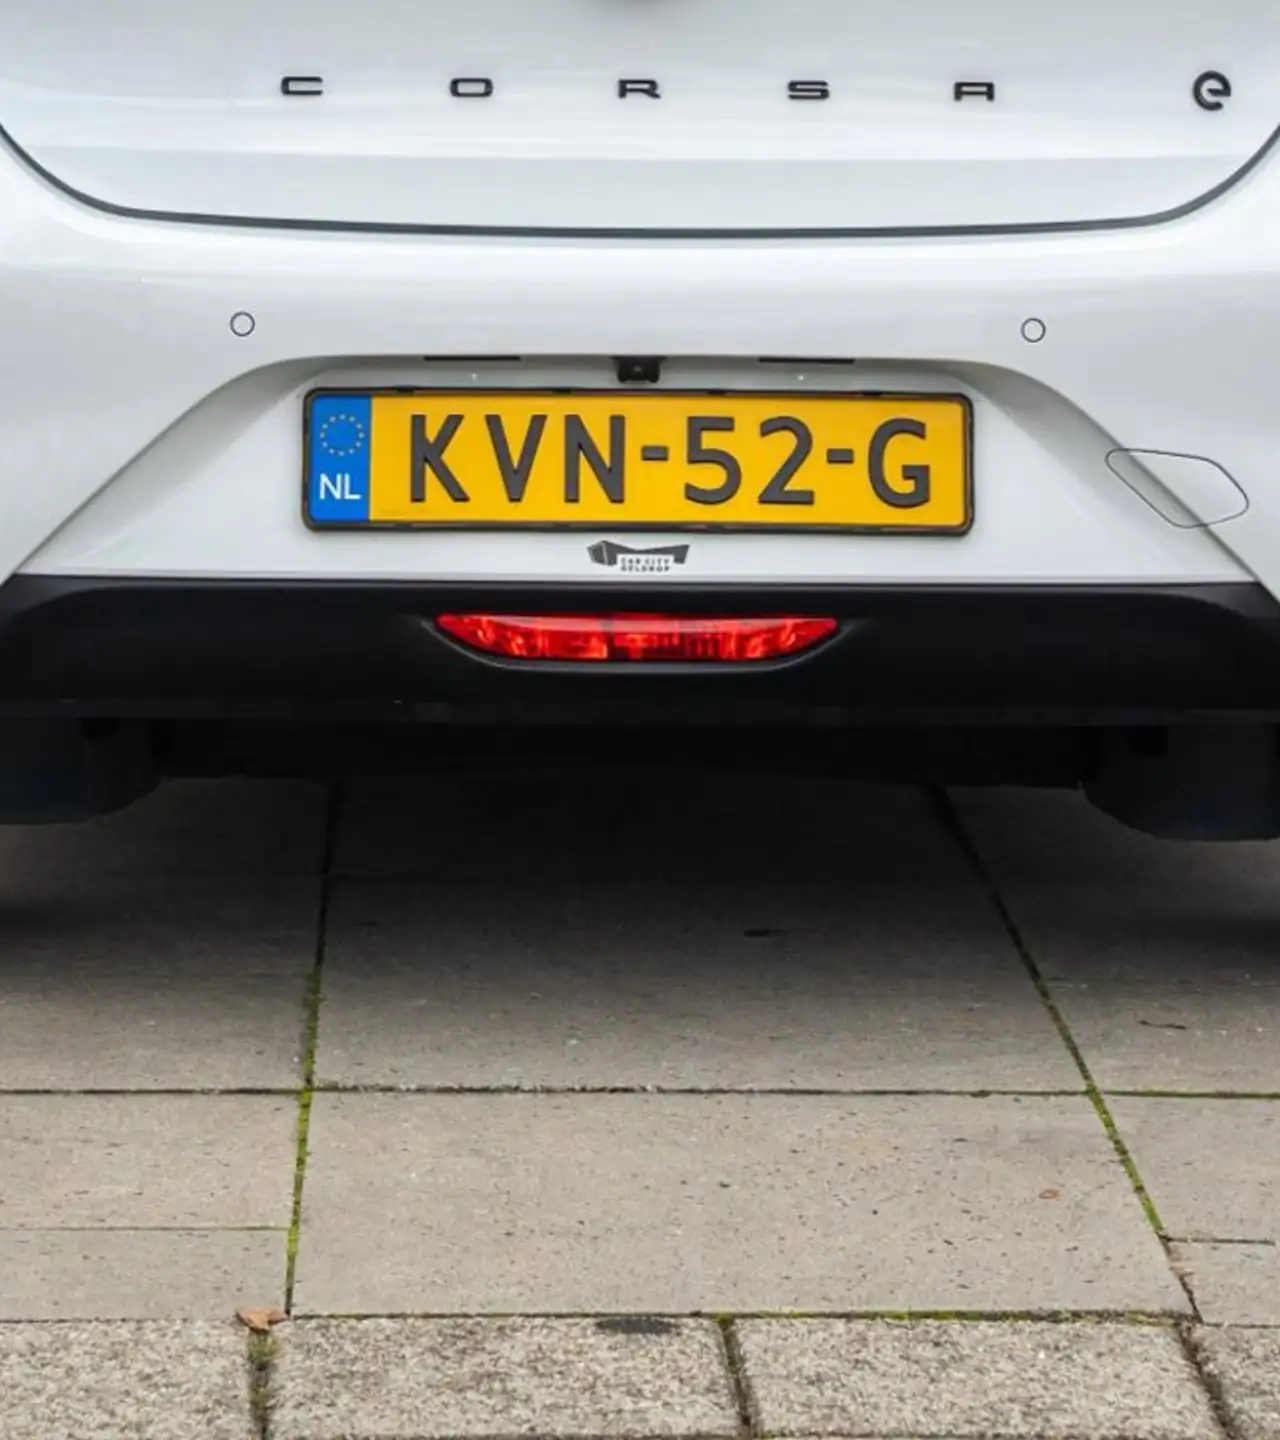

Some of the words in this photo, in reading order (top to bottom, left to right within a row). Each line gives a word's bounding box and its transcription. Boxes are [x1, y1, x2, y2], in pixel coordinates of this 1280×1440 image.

[279, 76, 996, 103] CORSA
[319, 473, 362, 500] NL
[410, 414, 932, 509] KVN-52-G
